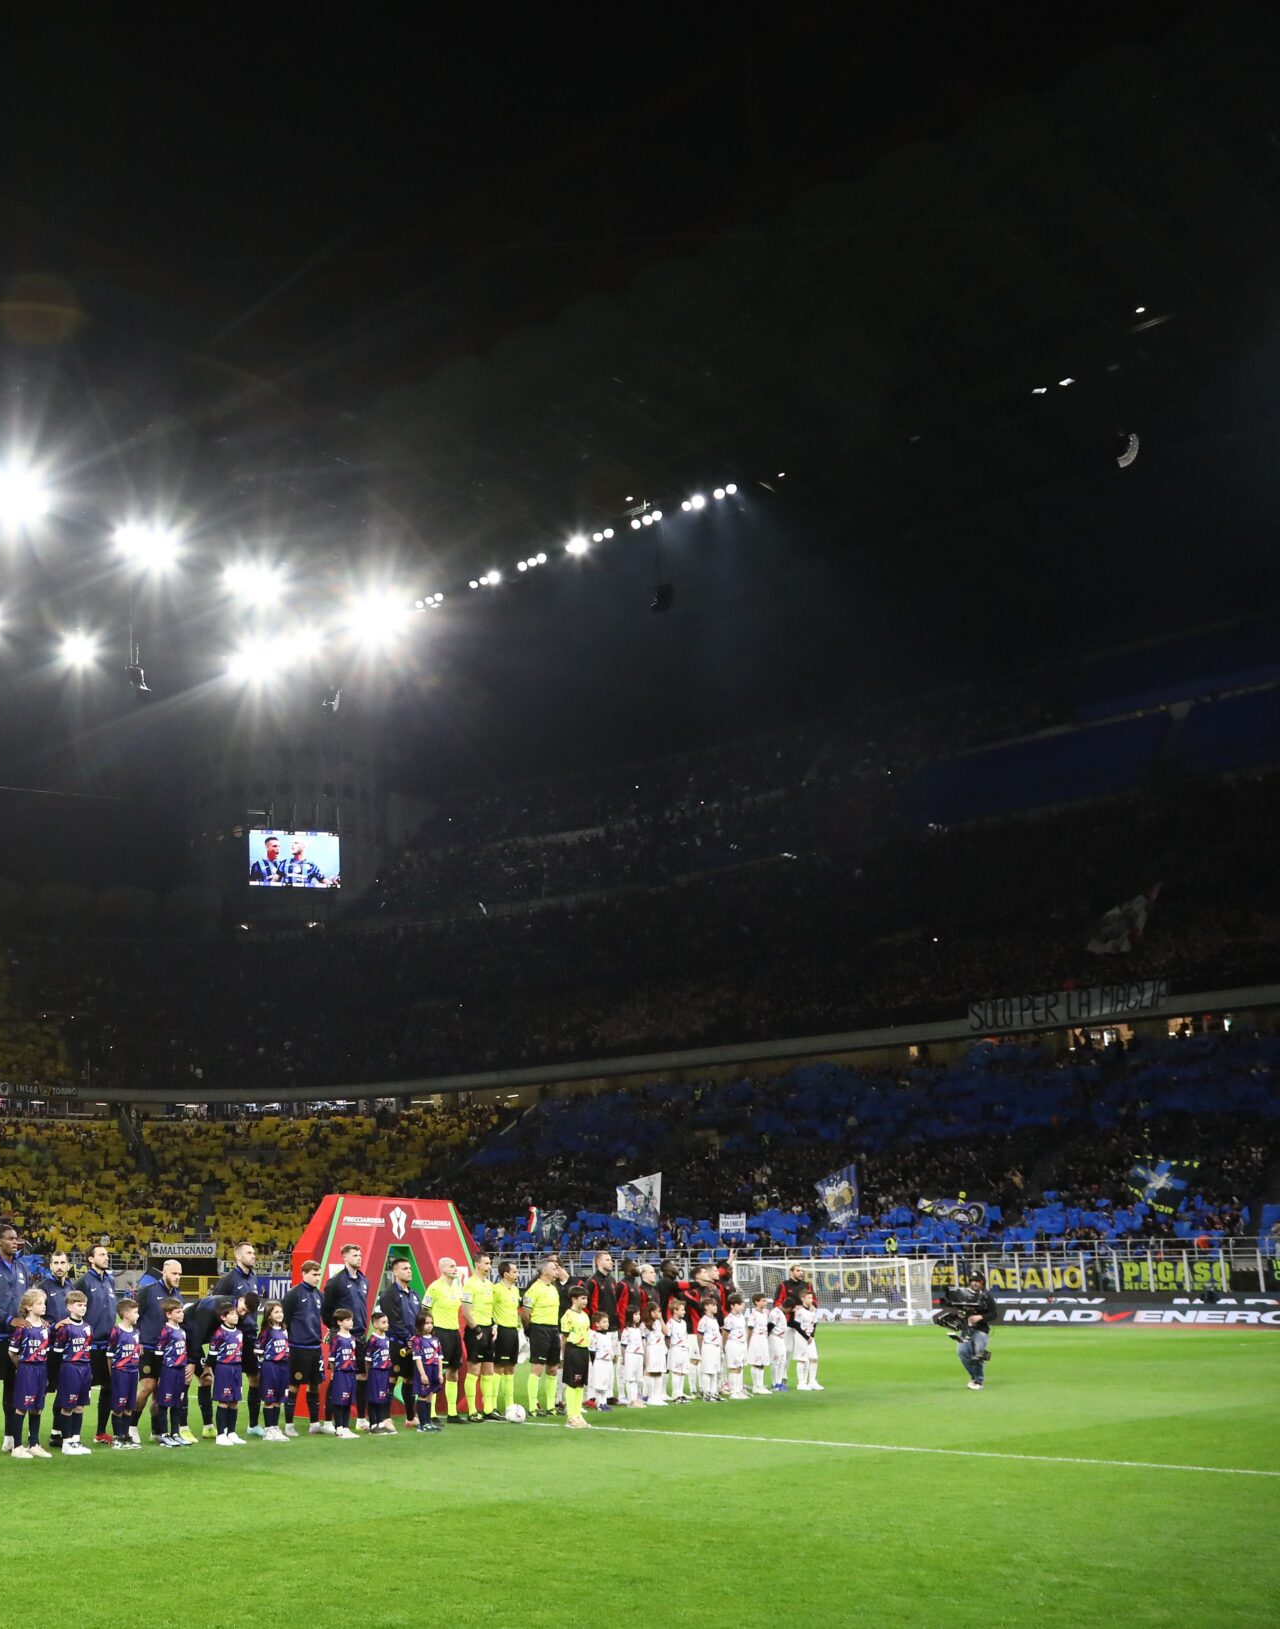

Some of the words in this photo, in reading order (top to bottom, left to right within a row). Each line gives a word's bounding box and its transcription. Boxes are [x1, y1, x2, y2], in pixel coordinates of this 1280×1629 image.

[970, 1001, 1013, 1031] SOLO
[1019, 995, 1058, 1025] PER
[1066, 988, 1091, 1020] LA
[159, 1246, 214, 1256] MALTIGNANO
[989, 1266, 1083, 1290] ABANO
[1122, 1261, 1231, 1283] PEGASO
[1003, 1309, 1102, 1323] MAD
